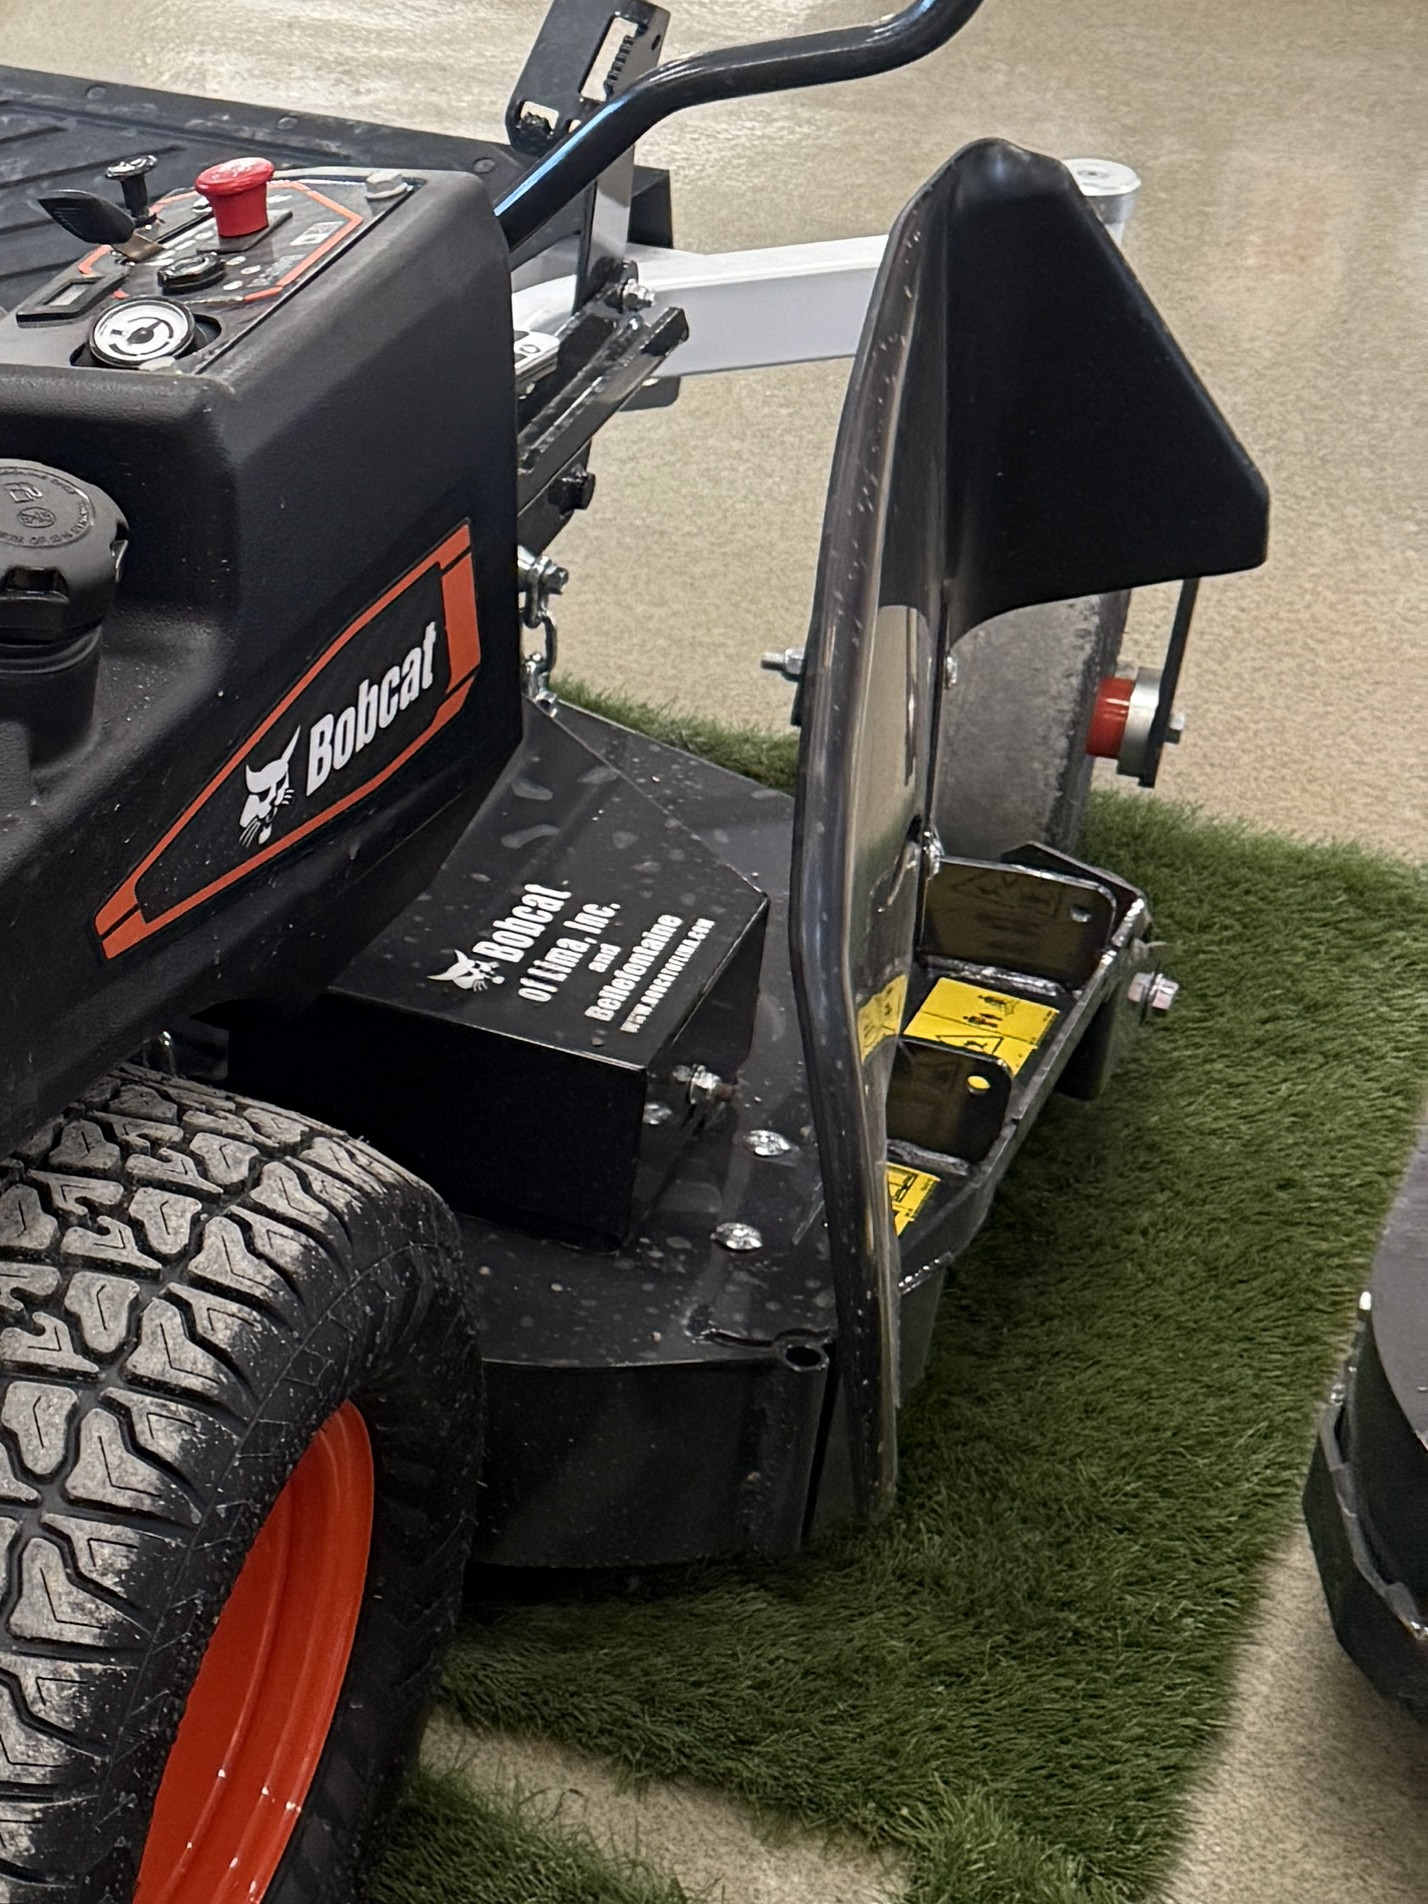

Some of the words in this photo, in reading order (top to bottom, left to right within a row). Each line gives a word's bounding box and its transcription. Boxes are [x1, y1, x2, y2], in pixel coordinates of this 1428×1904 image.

[306, 621, 437, 797] Bobcat
[472, 883, 572, 963] Bobcat
[563, 903, 621, 934] Inc.
[527, 937, 597, 982] Lima,
[584, 914, 683, 1021] Bellefontaine
[588, 943, 621, 973] and
[518, 977, 558, 1002] of
